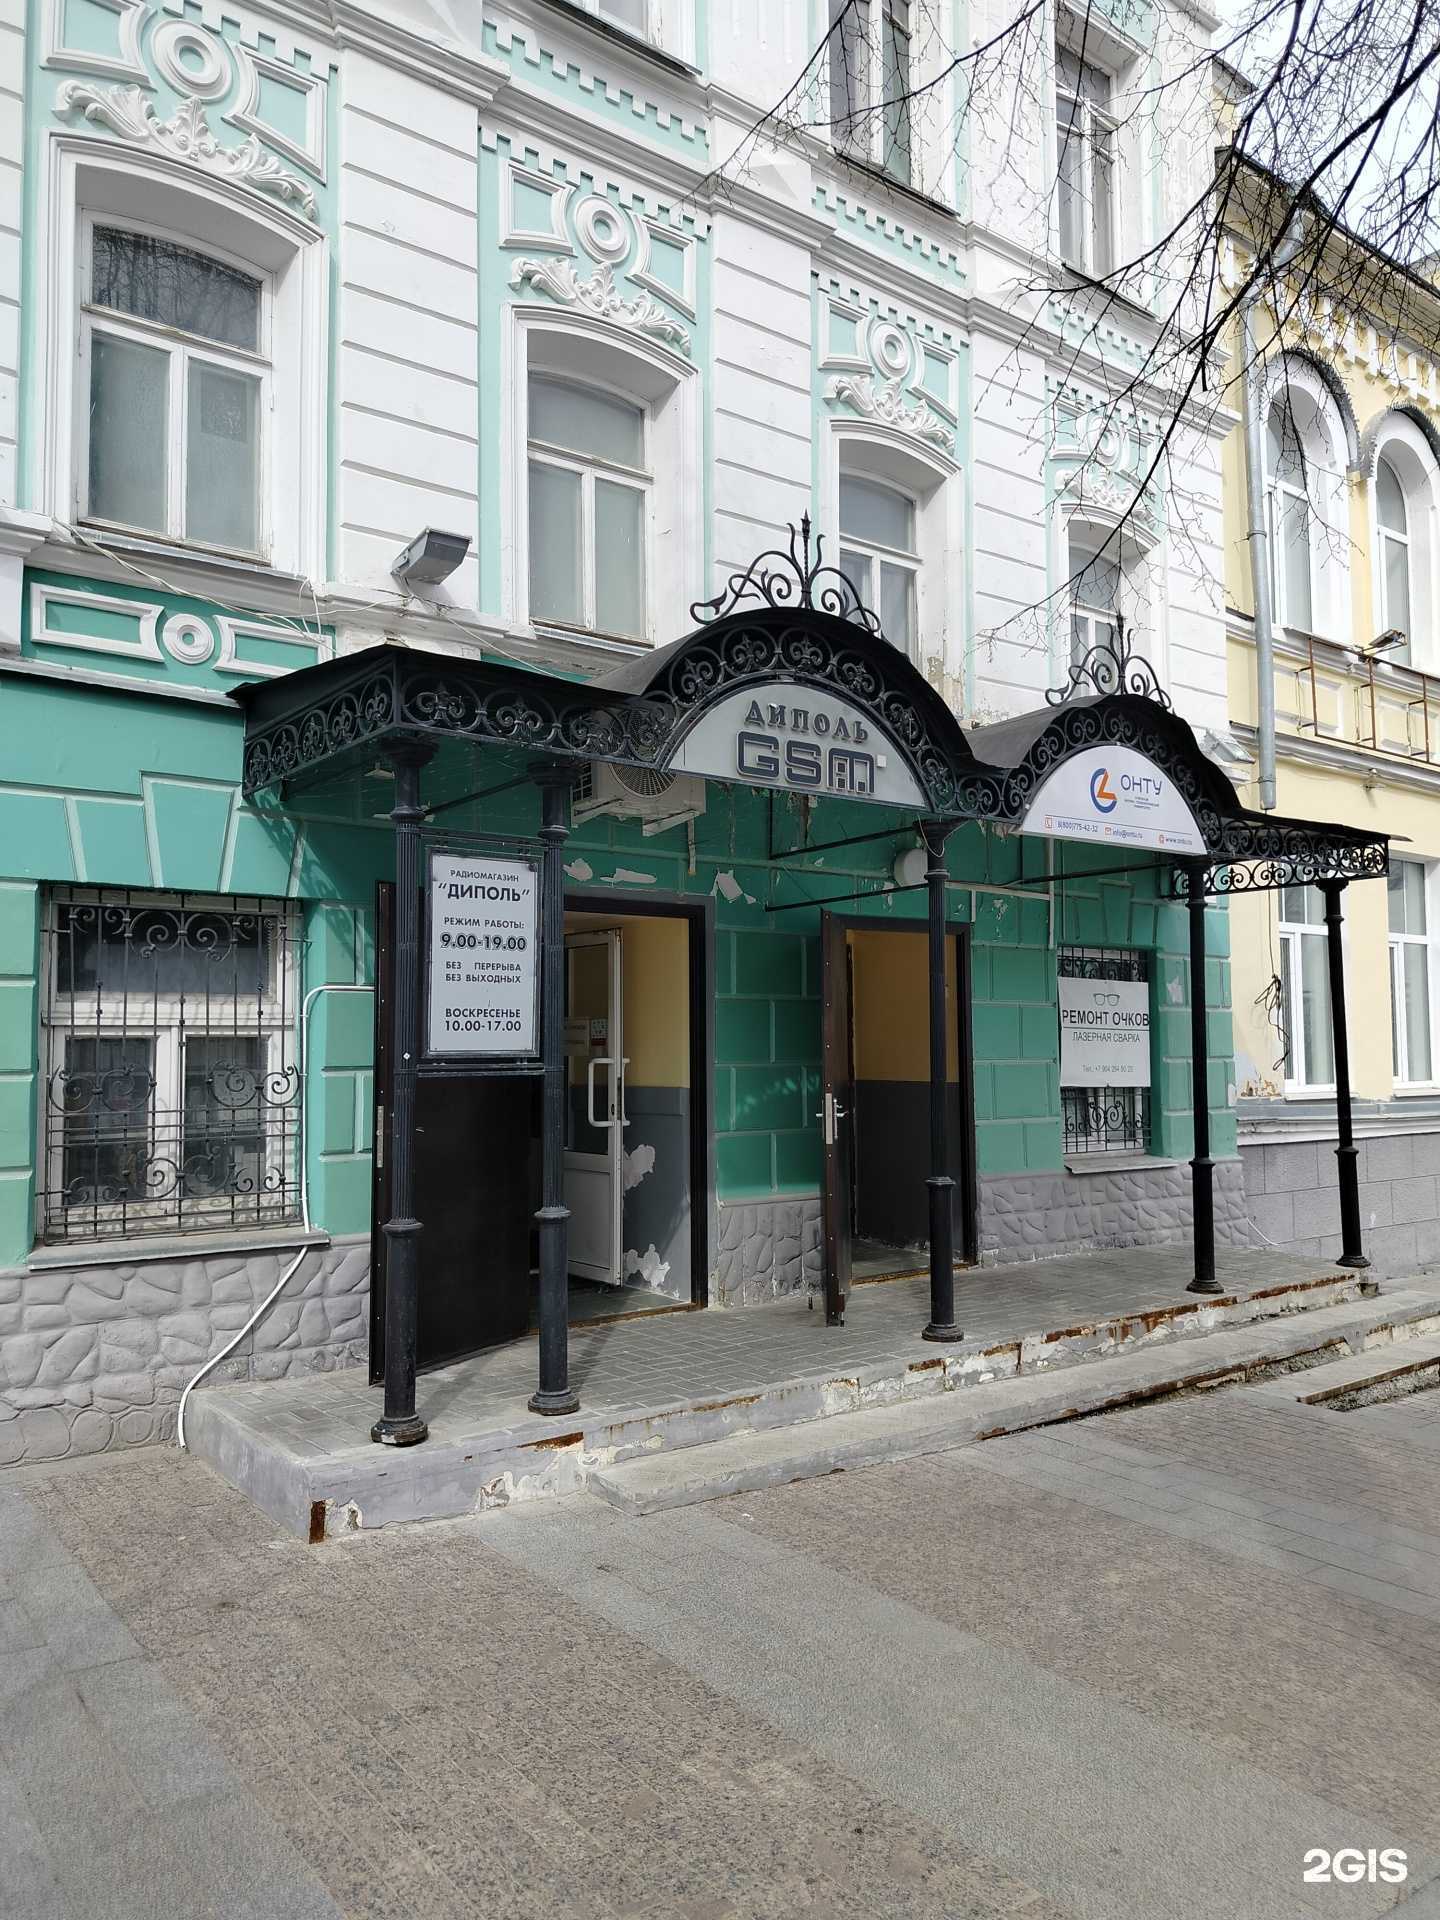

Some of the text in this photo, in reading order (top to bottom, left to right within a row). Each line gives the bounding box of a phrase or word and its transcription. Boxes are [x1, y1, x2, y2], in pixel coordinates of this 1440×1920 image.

[744, 700, 868, 743] ДИПОЛЬ
[736, 730, 876, 795] GSM
[1120, 774, 1162, 795] ОНТУ
[450, 869, 519, 883] РАДИОМАГАЗИН
[444, 916, 525, 929] РЕЖИМ РАБОТЫ:
[440, 933, 527, 951] 9.00-19.00
[445, 961, 522, 972] БЕЗ ПЕРЕРЫВА
[445, 973, 521, 984] БЕЗ ВЫХОДНЫХ
[445, 1008, 521, 1018] ВОСКРЕСЕНЬЕ
[1062, 1009, 1149, 1026] РЕМОНТ ОЧКОВ
[445, 1020, 522, 1032] 10.00-17.00
[1072, 1031, 1140, 1043] ЛАЗЕРНАЯ СВАРКА
